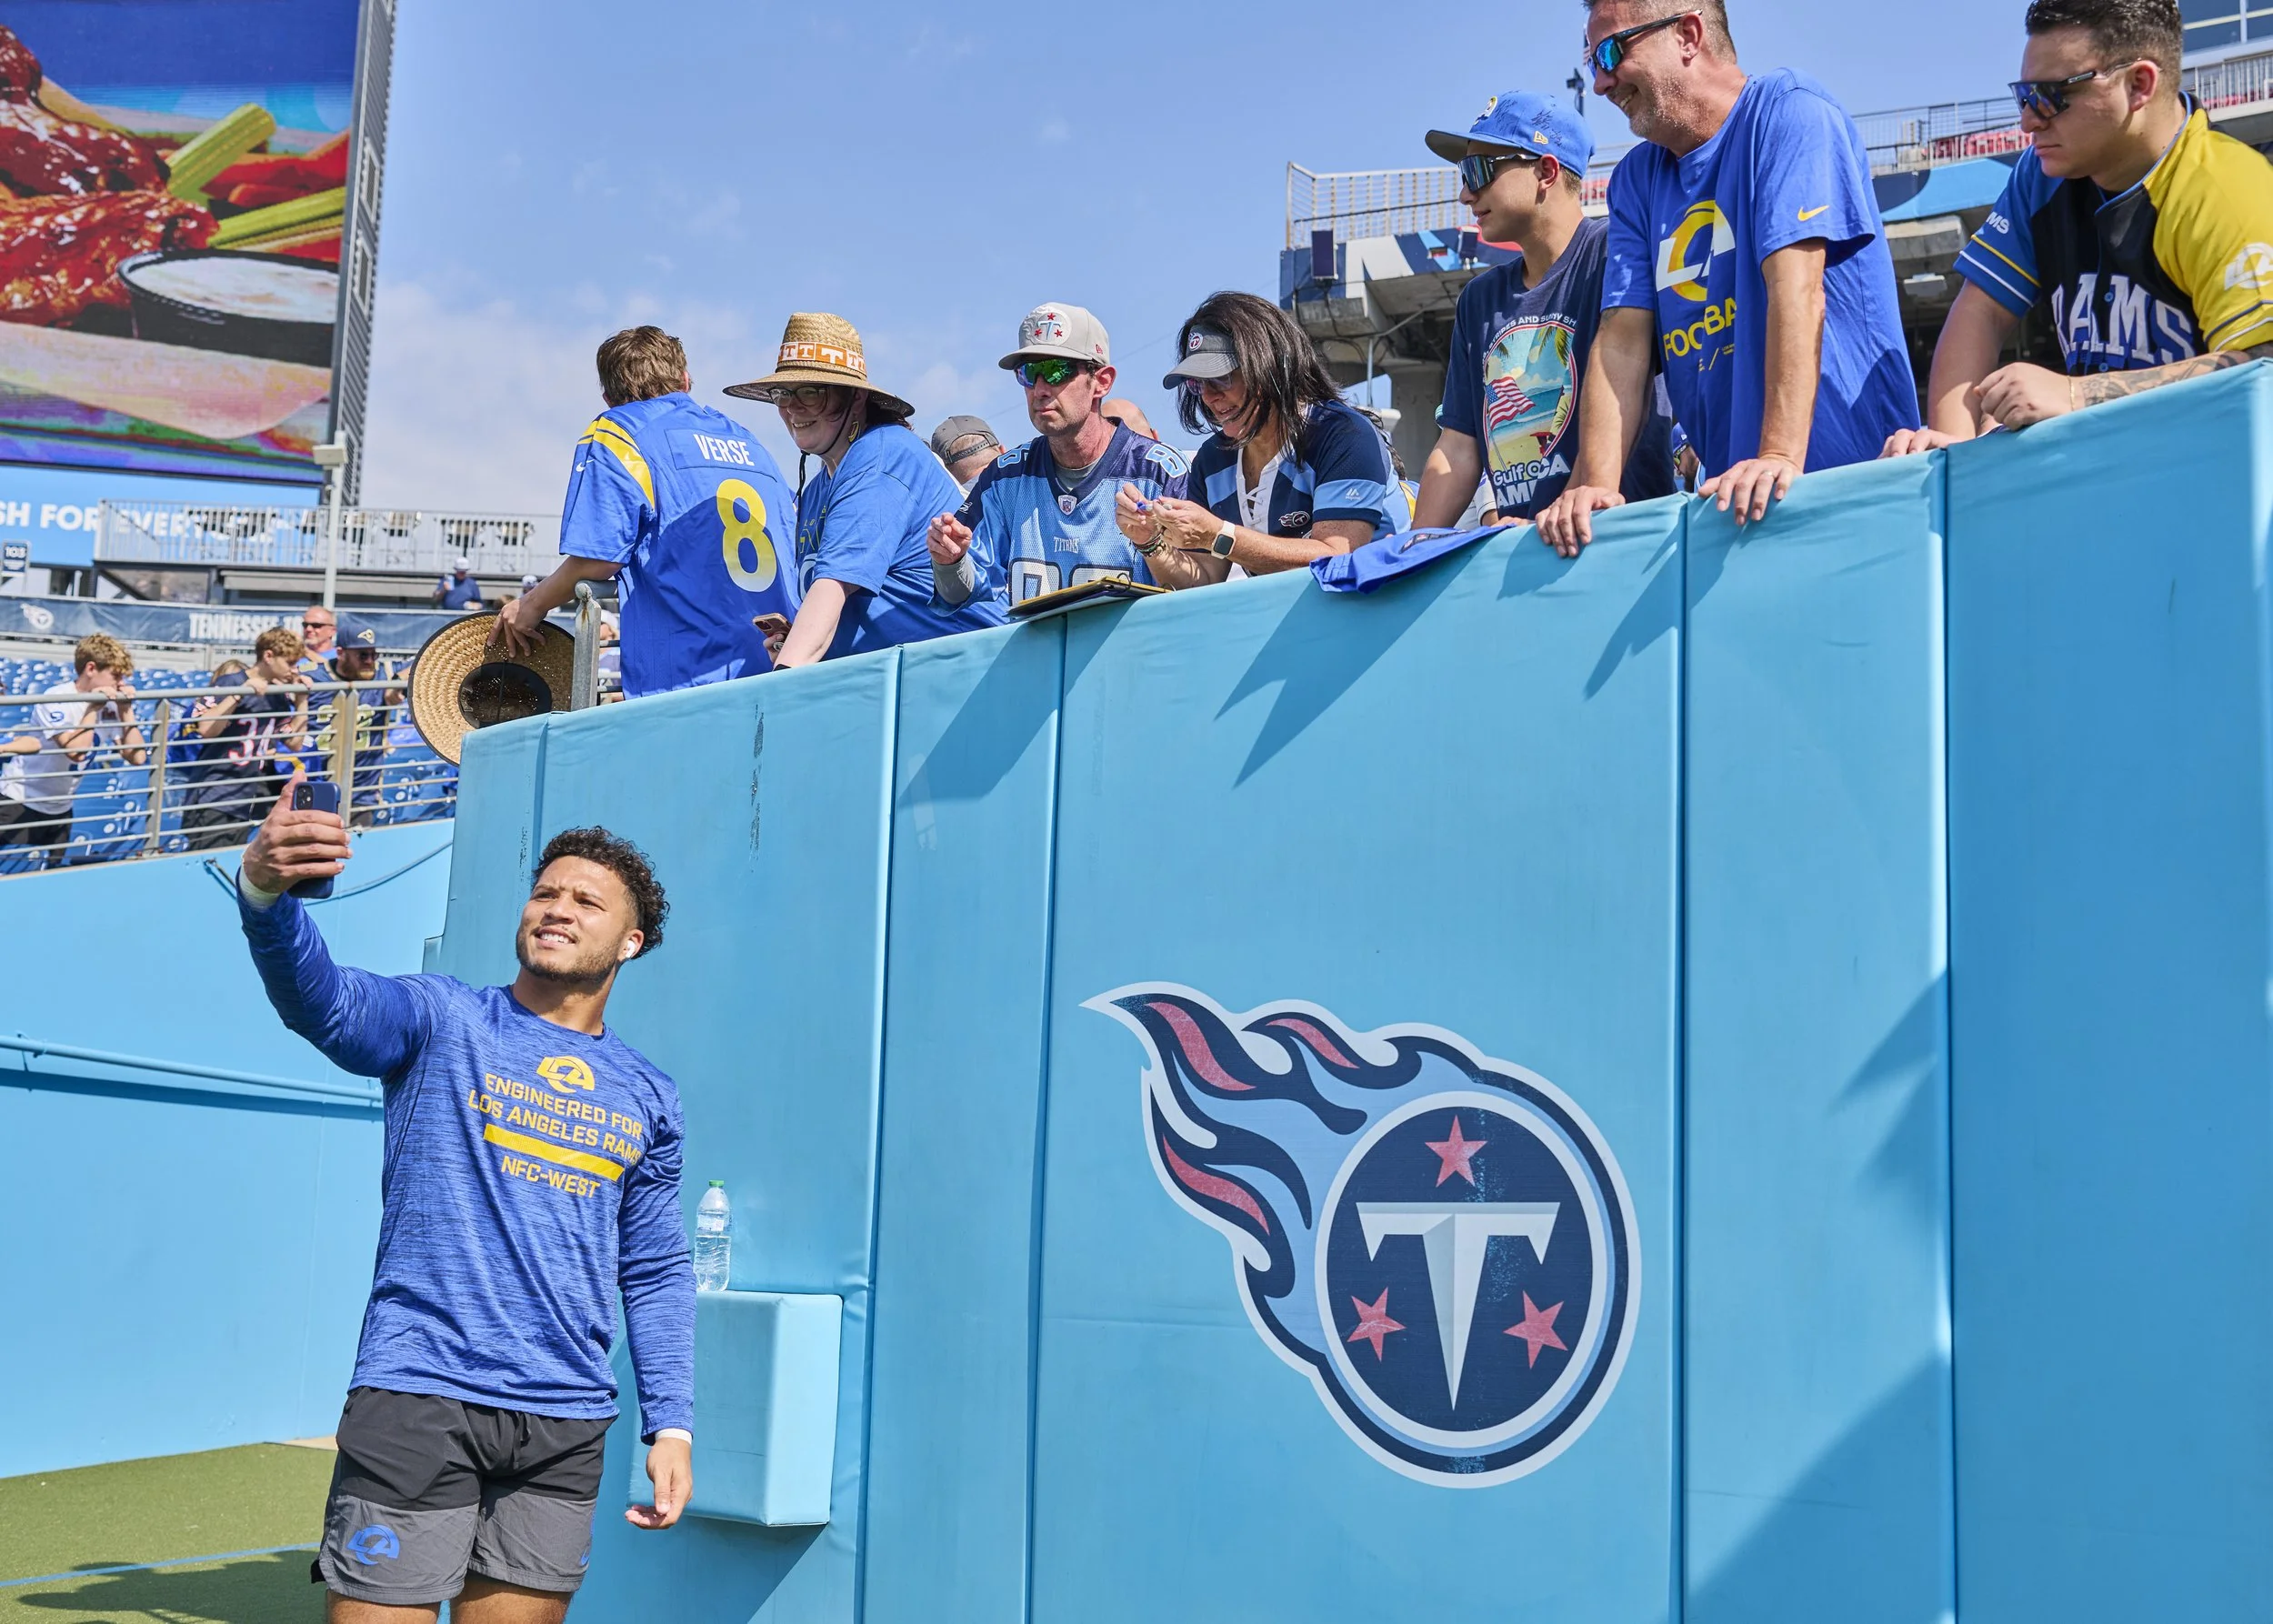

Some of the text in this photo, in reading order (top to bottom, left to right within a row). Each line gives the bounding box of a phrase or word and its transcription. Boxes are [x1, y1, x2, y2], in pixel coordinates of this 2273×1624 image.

[1986, 212, 2009, 234] MS
[1517, 316, 1539, 325] AND
[693, 434, 755, 466] VERSE
[1493, 464, 1525, 486] Gulf
[40, 504, 99, 532] FOR
[716, 478, 776, 592] 8
[1054, 536, 1079, 554] TITANS
[228, 717, 275, 770] 34
[485, 1073, 643, 1140] ENGINEERED FOR
[468, 1089, 642, 1166] LOS ANGELES RAMS
[501, 1155, 601, 1198] NFC-WEST
